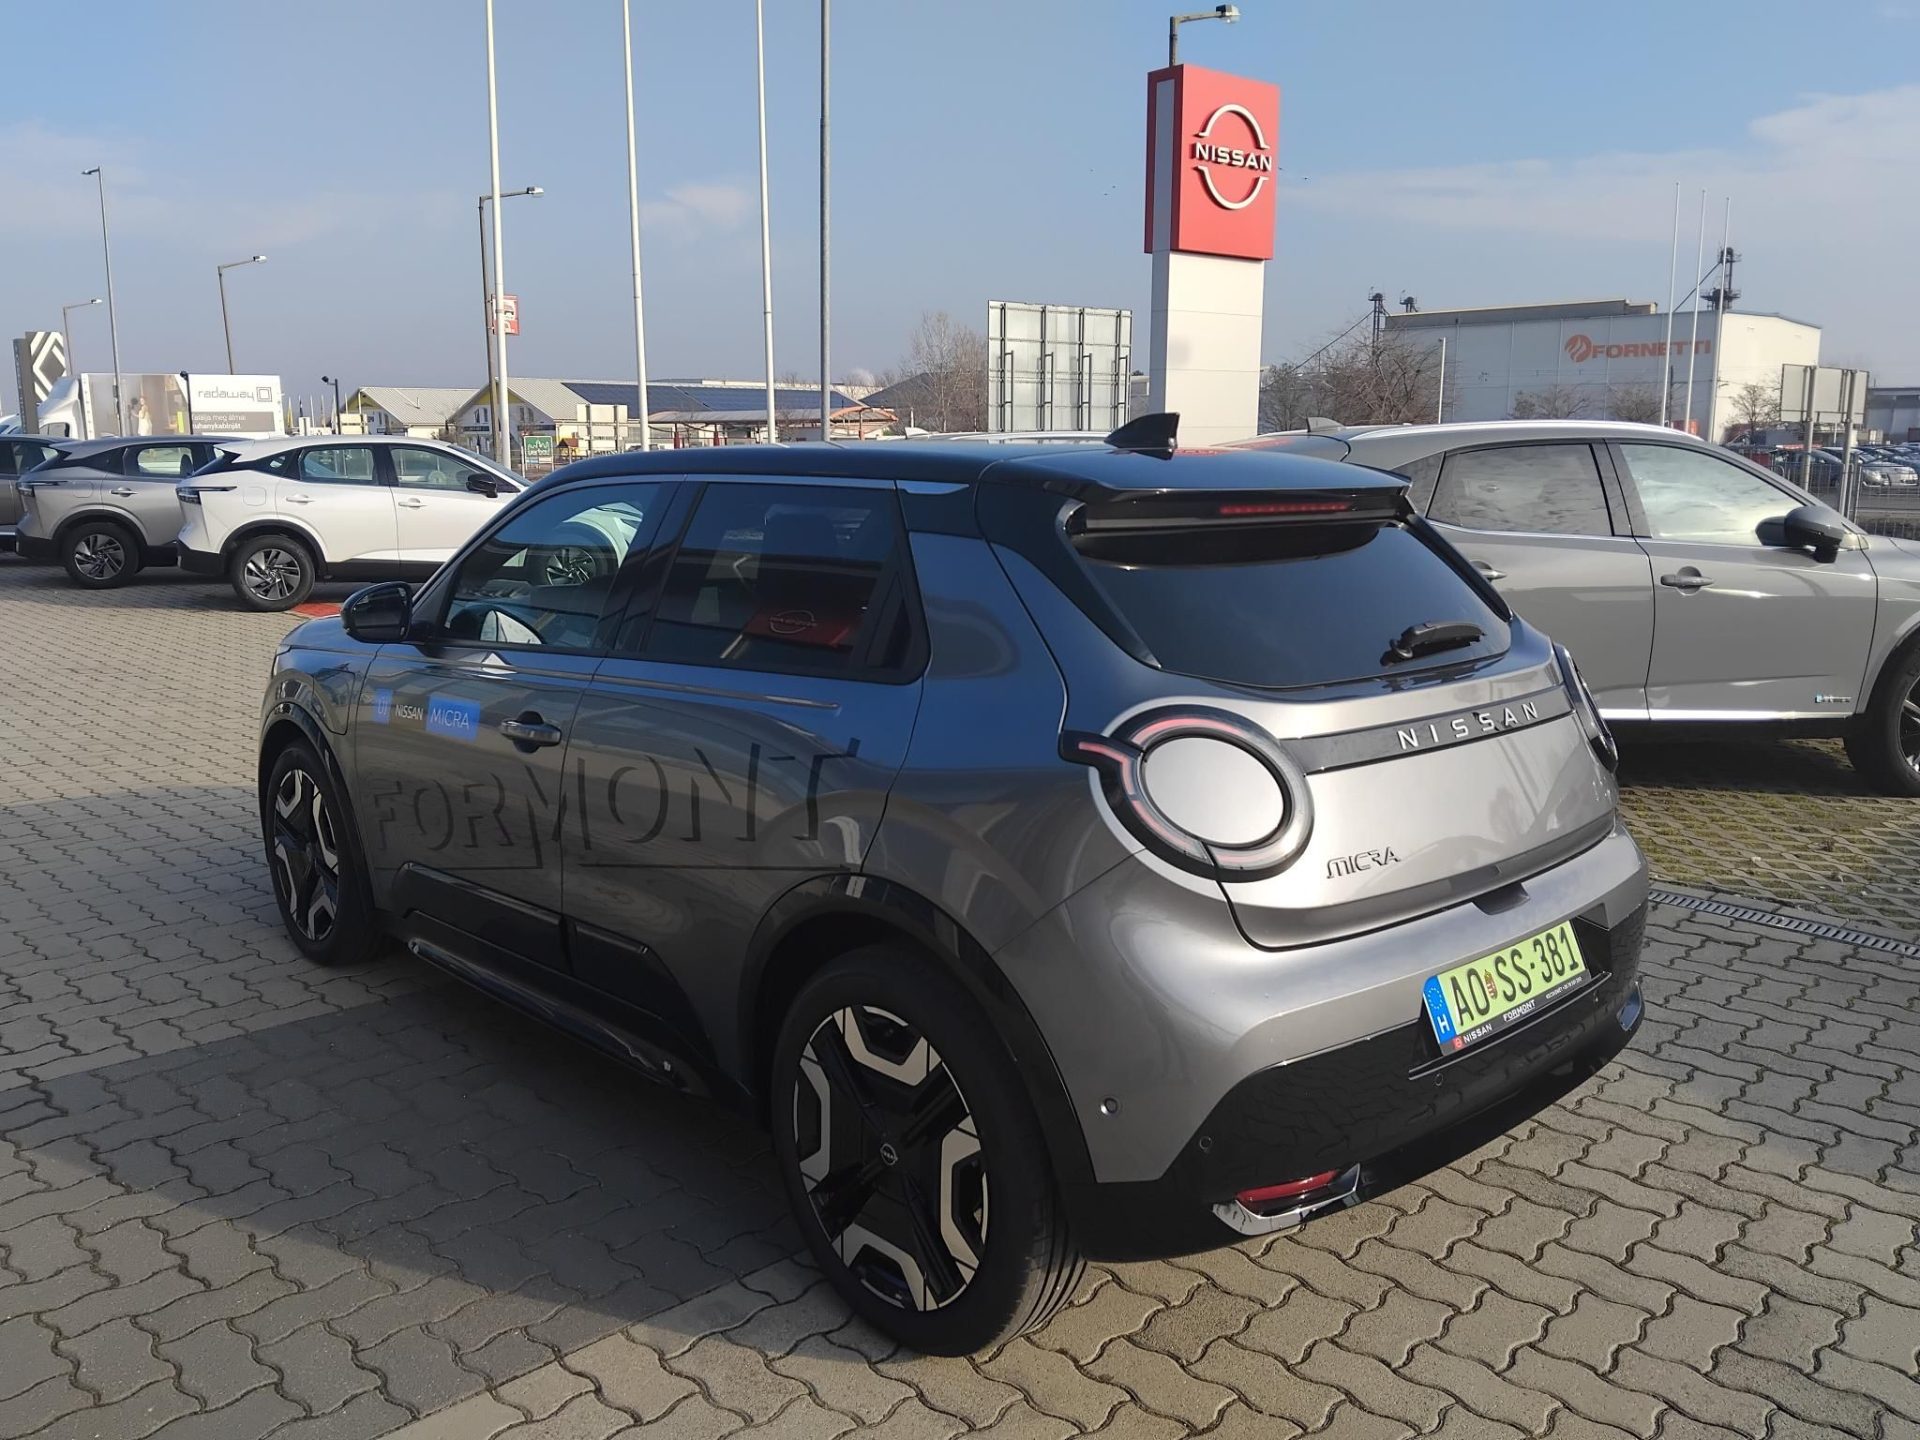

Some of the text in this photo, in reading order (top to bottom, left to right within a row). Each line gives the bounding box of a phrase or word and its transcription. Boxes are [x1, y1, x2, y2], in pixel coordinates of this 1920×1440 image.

[1194, 141, 1272, 172] NISSAN
[1591, 339, 1712, 359] FORNETTI
[197, 386, 255, 401] radaway
[395, 704, 424, 721] NISSAN
[430, 707, 470, 730] MICRA
[1396, 701, 1539, 750] NISSAN
[372, 737, 861, 868] FORMONT
[1325, 846, 1402, 879] MICRA
[1450, 967, 1491, 1026] AO
[1436, 1013, 1451, 1035] H
[1462, 1023, 1493, 1044] NISSAN
